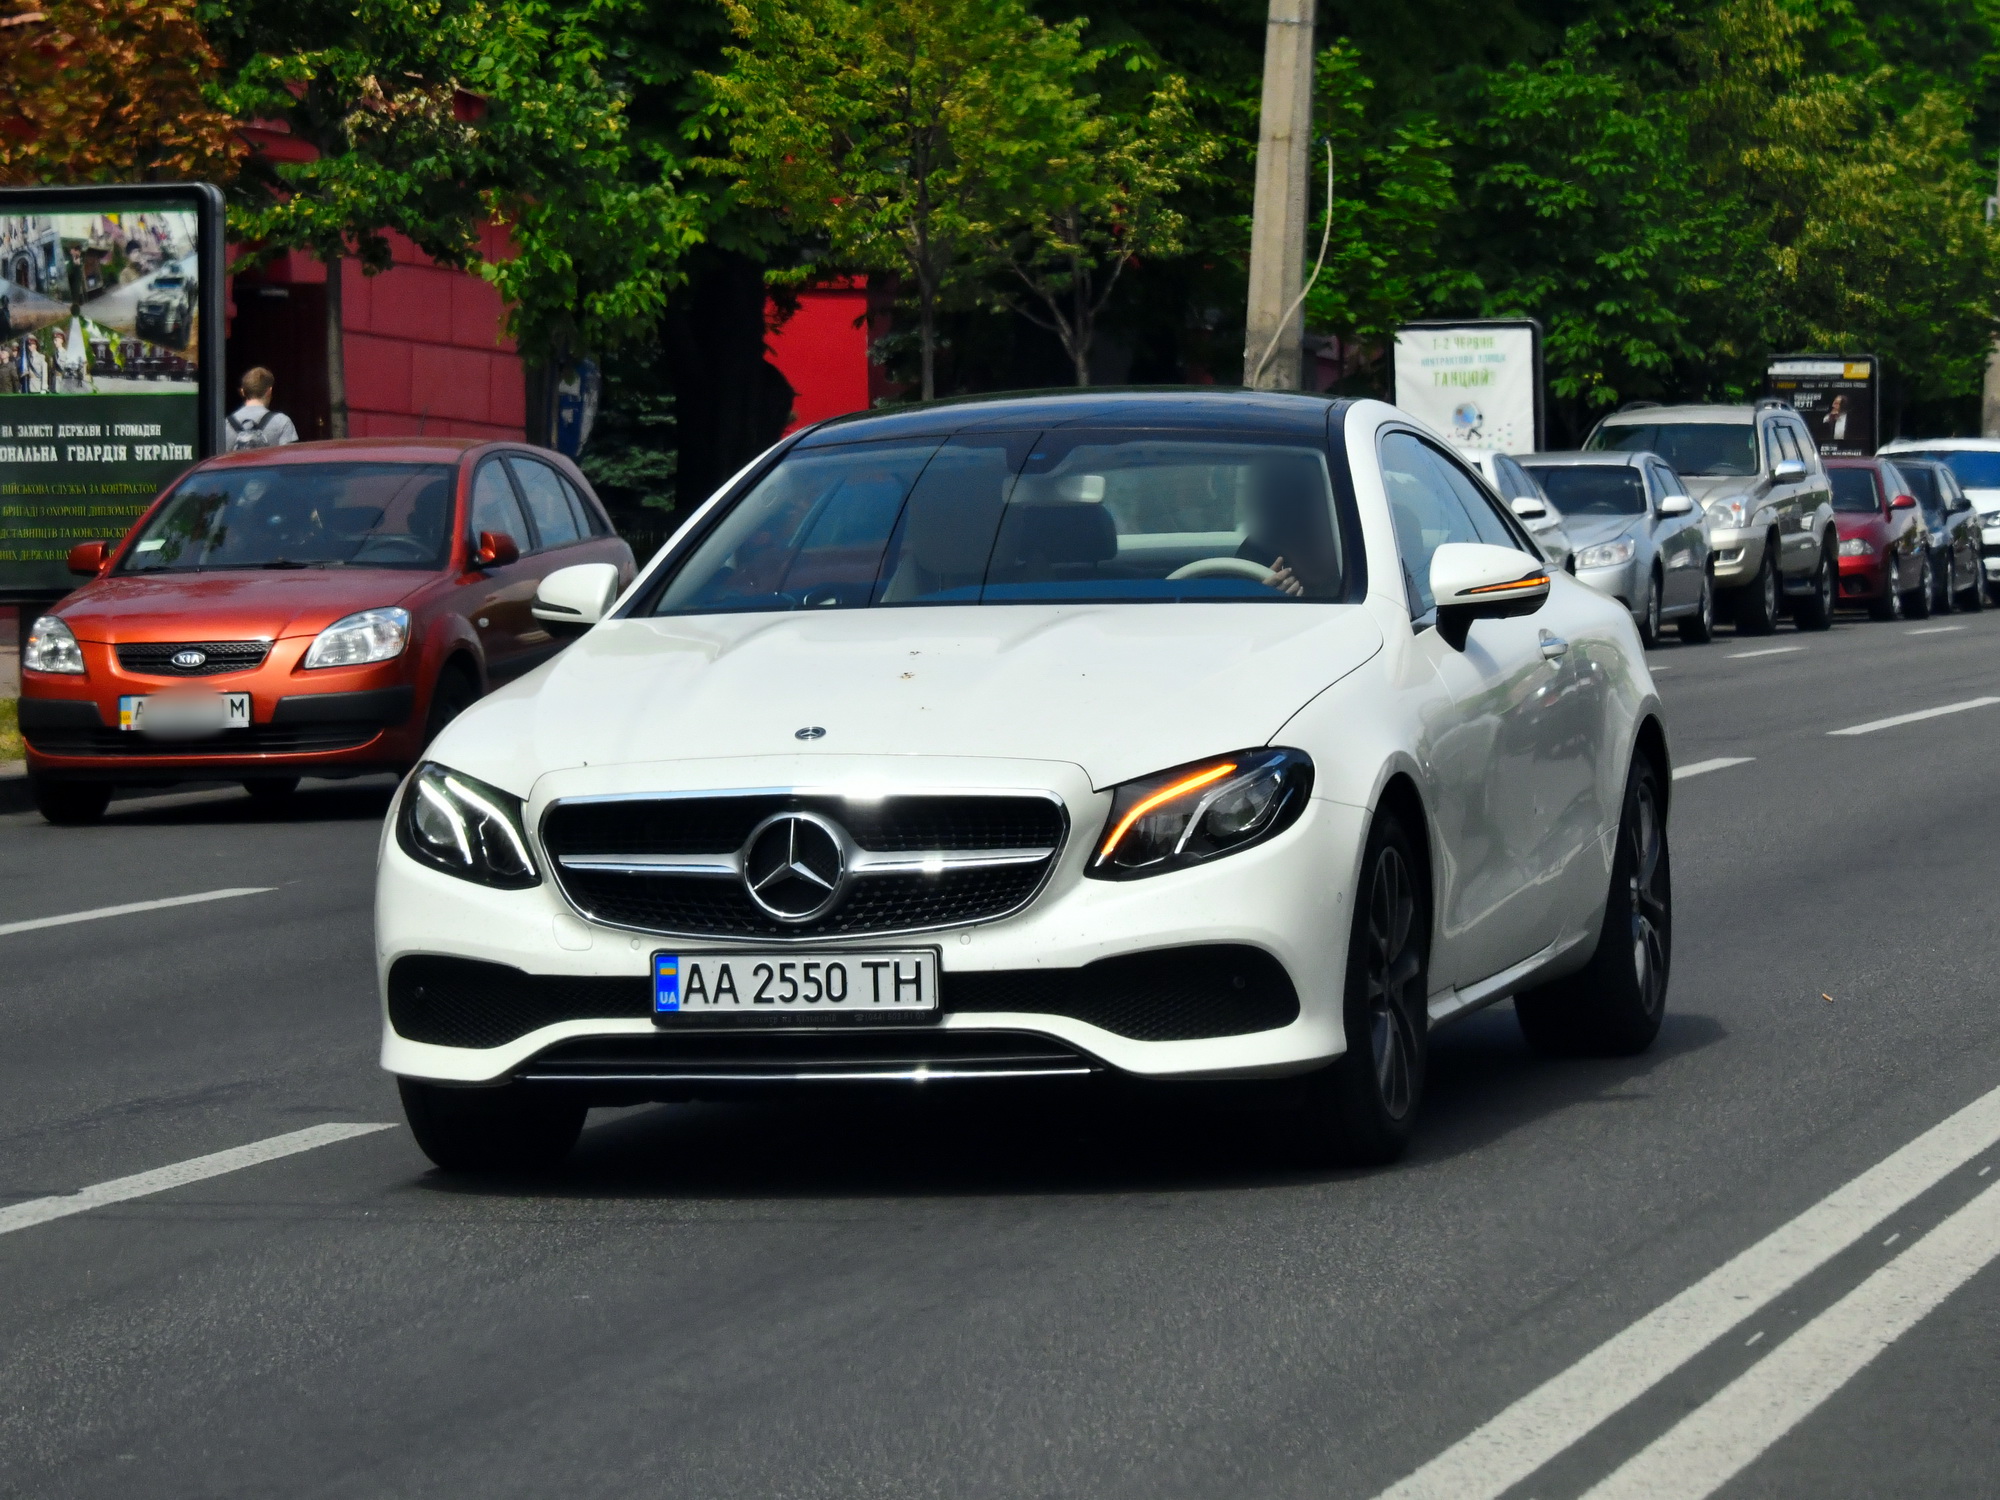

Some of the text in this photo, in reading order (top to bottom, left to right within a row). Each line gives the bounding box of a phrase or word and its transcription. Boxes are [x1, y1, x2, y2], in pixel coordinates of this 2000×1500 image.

[2, 425, 13, 437] НА
[17, 425, 54, 437] ЗАХИСТІ
[58, 425, 101, 438] ДЕРЖАВИ
[114, 424, 162, 437] ГРОМАДЯН
[67, 445, 127, 462] ГВАРДІЯ
[135, 443, 193, 461] УКРАЇНИ
[51, 484, 87, 494] СЛУЖБА
[89, 484, 99, 494] ЗА
[101, 484, 157, 494] КОНТРАКТОМ
[46, 506, 86, 516] ОХОРОНИ
[60, 528, 70, 538] ТА
[683, 960, 923, 1004] AA 2550 TH
[660, 992, 677, 1004] UA
